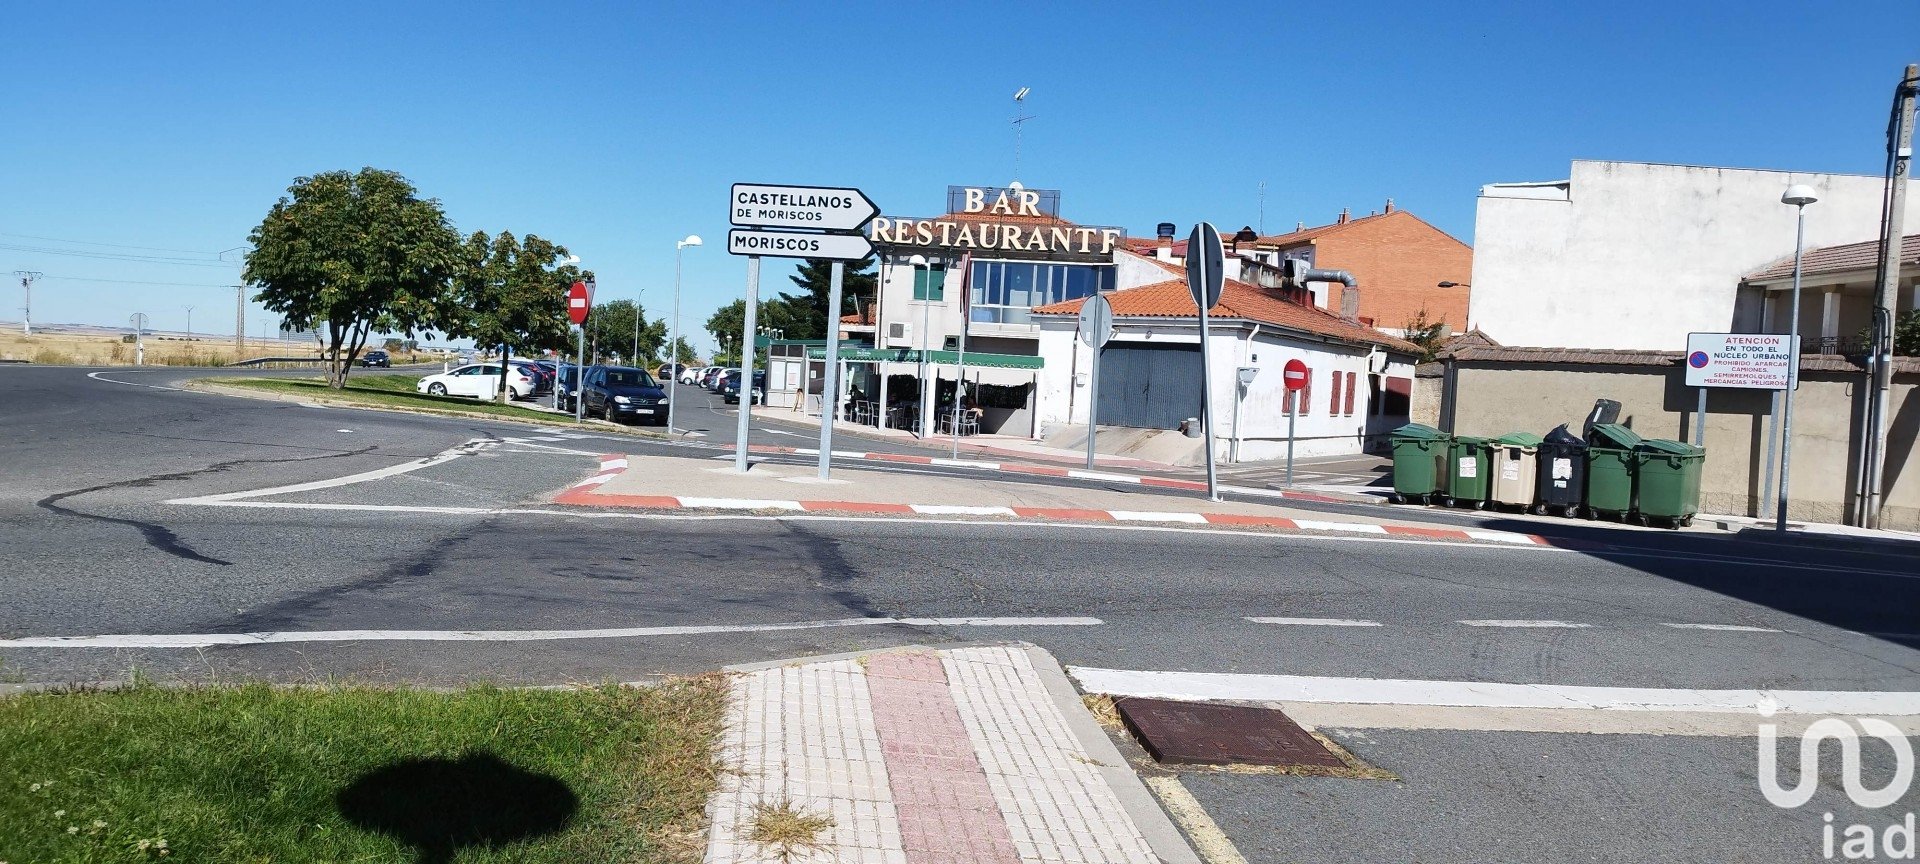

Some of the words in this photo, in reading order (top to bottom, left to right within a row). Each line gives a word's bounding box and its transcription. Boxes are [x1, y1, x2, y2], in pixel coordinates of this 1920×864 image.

[737, 192, 852, 209] CASTELLANOS
[964, 188, 1042, 217] BAR
[737, 208, 752, 218] DE
[758, 209, 823, 221] MORISCOS
[734, 236, 820, 251] MORISCOS
